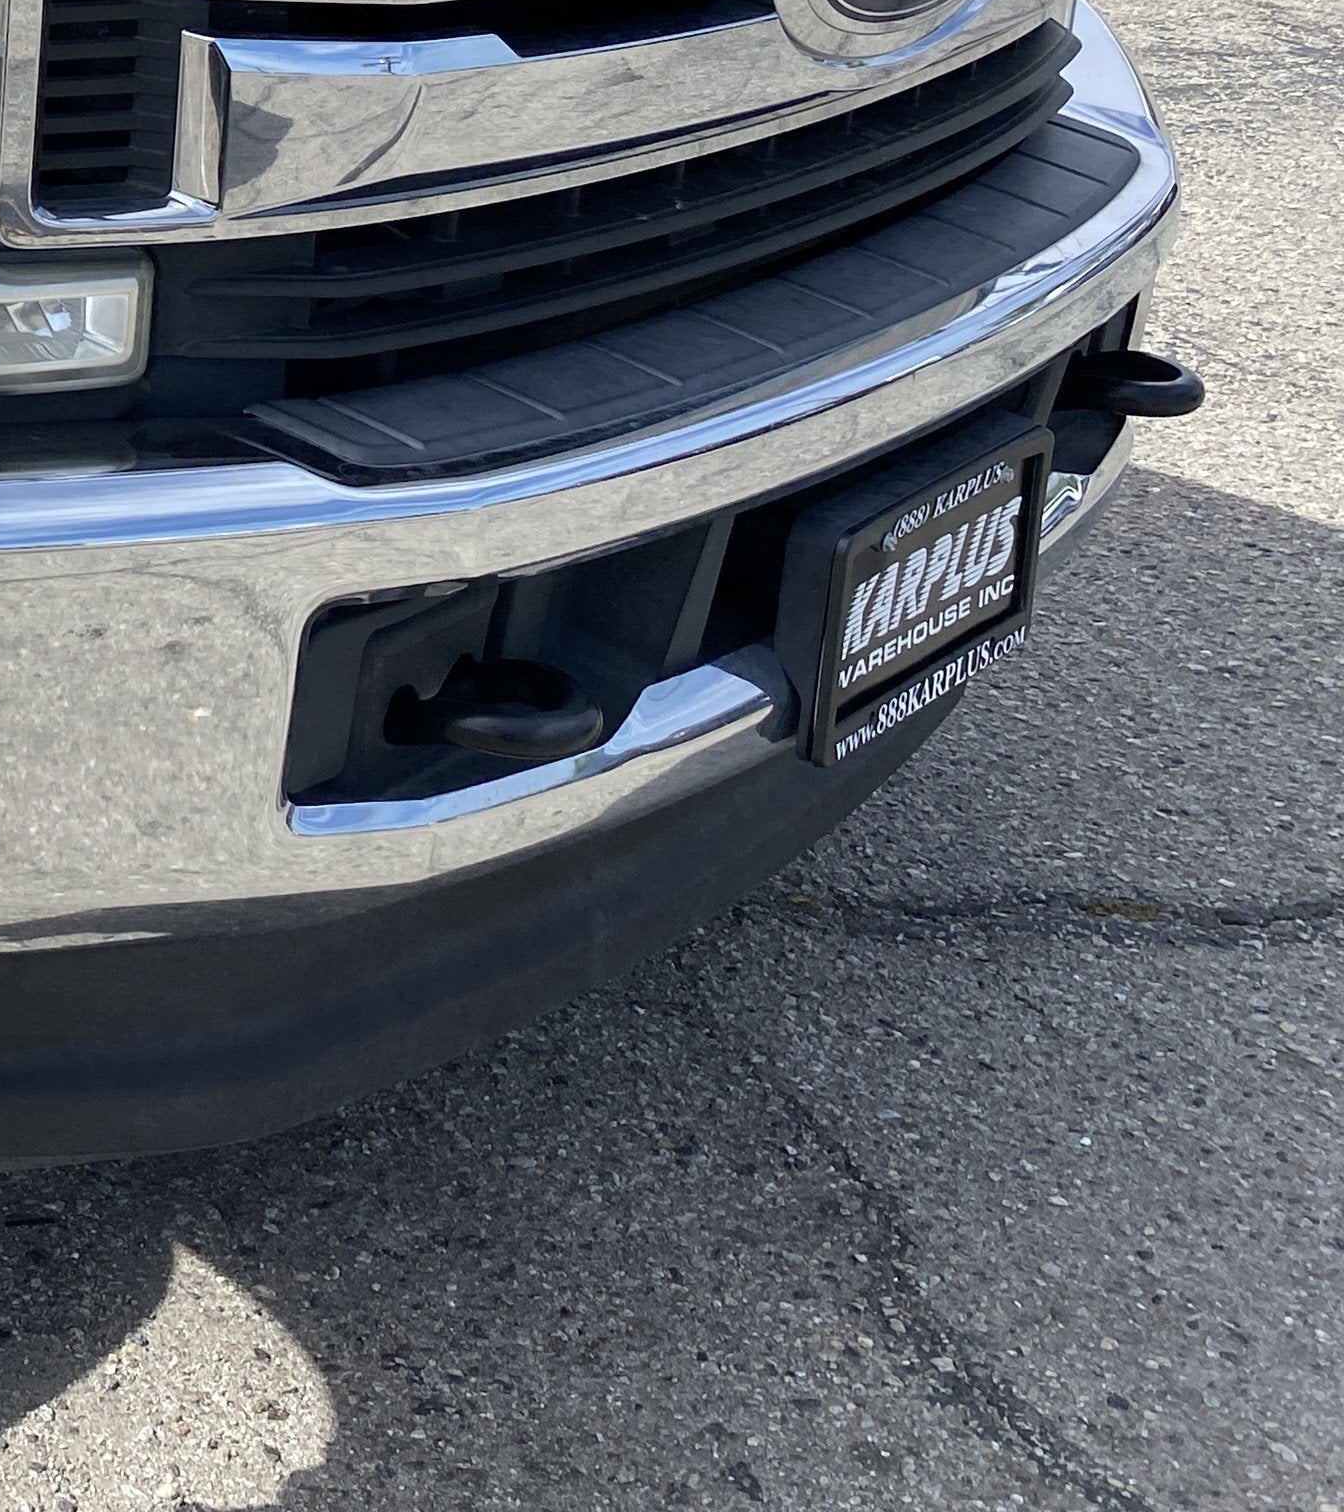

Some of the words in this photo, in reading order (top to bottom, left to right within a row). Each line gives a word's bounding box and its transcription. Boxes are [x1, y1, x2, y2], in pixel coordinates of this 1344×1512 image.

[932, 460, 1006, 519] KARPLUS
[837, 595, 971, 689] WAREHOUSE
[978, 573, 1016, 609] INC
[840, 495, 1023, 661] KARPLUS
